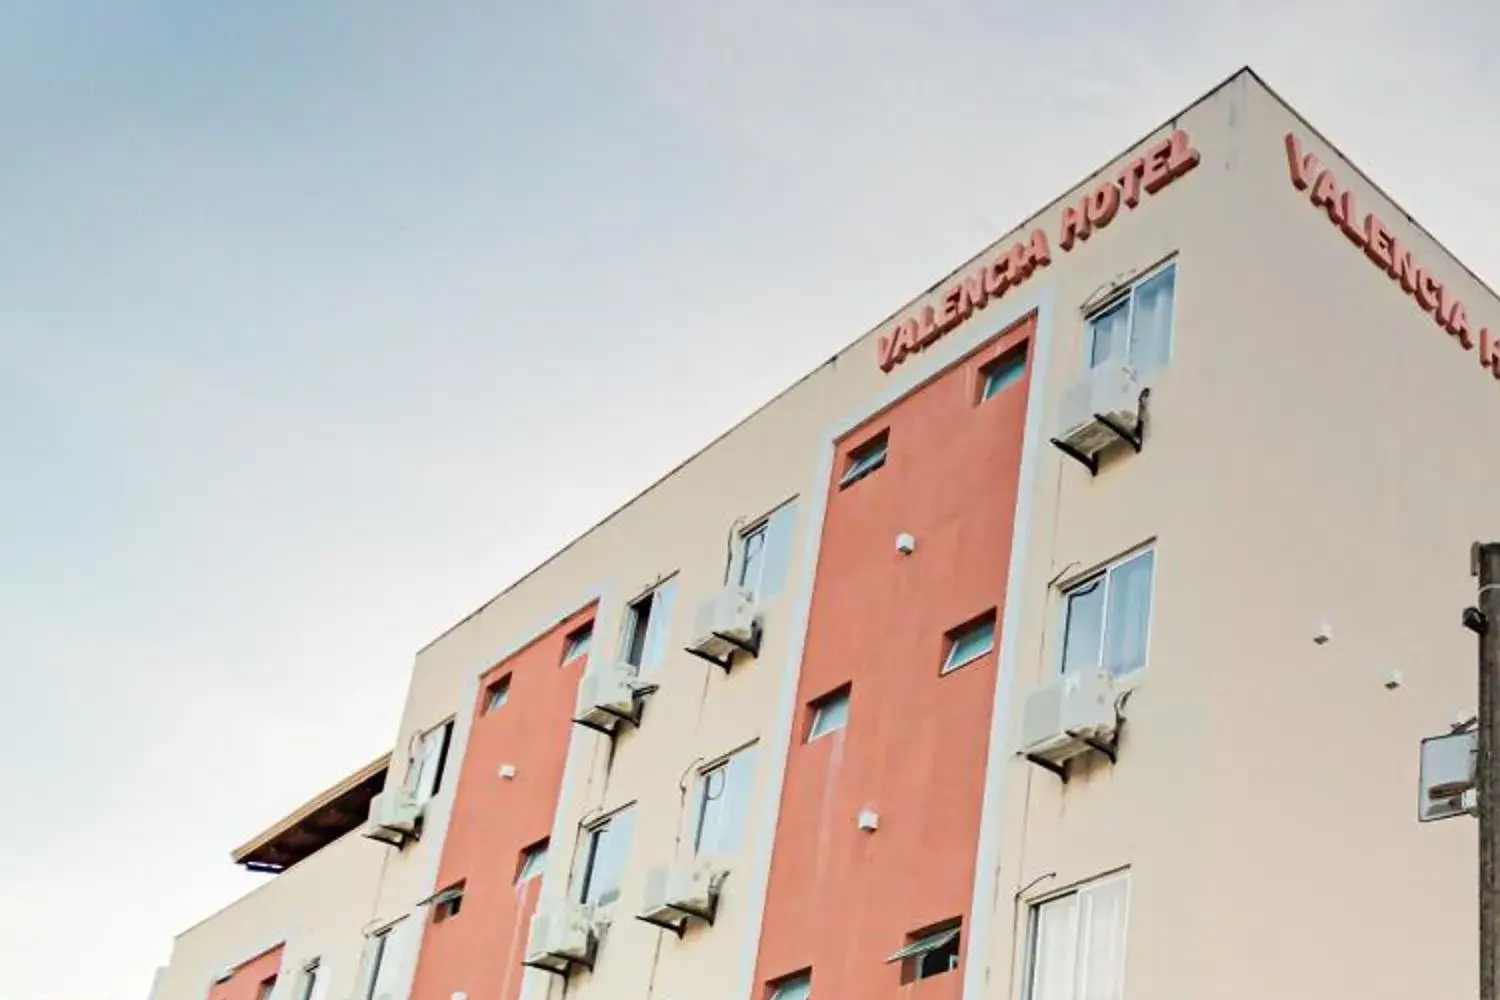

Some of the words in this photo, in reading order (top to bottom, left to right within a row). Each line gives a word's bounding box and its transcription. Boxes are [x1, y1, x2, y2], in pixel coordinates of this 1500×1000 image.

[877, 228, 1051, 374] VALENCIA
[1060, 129, 1201, 252] HOTEL
[1284, 131, 1474, 350] VALENCIA
